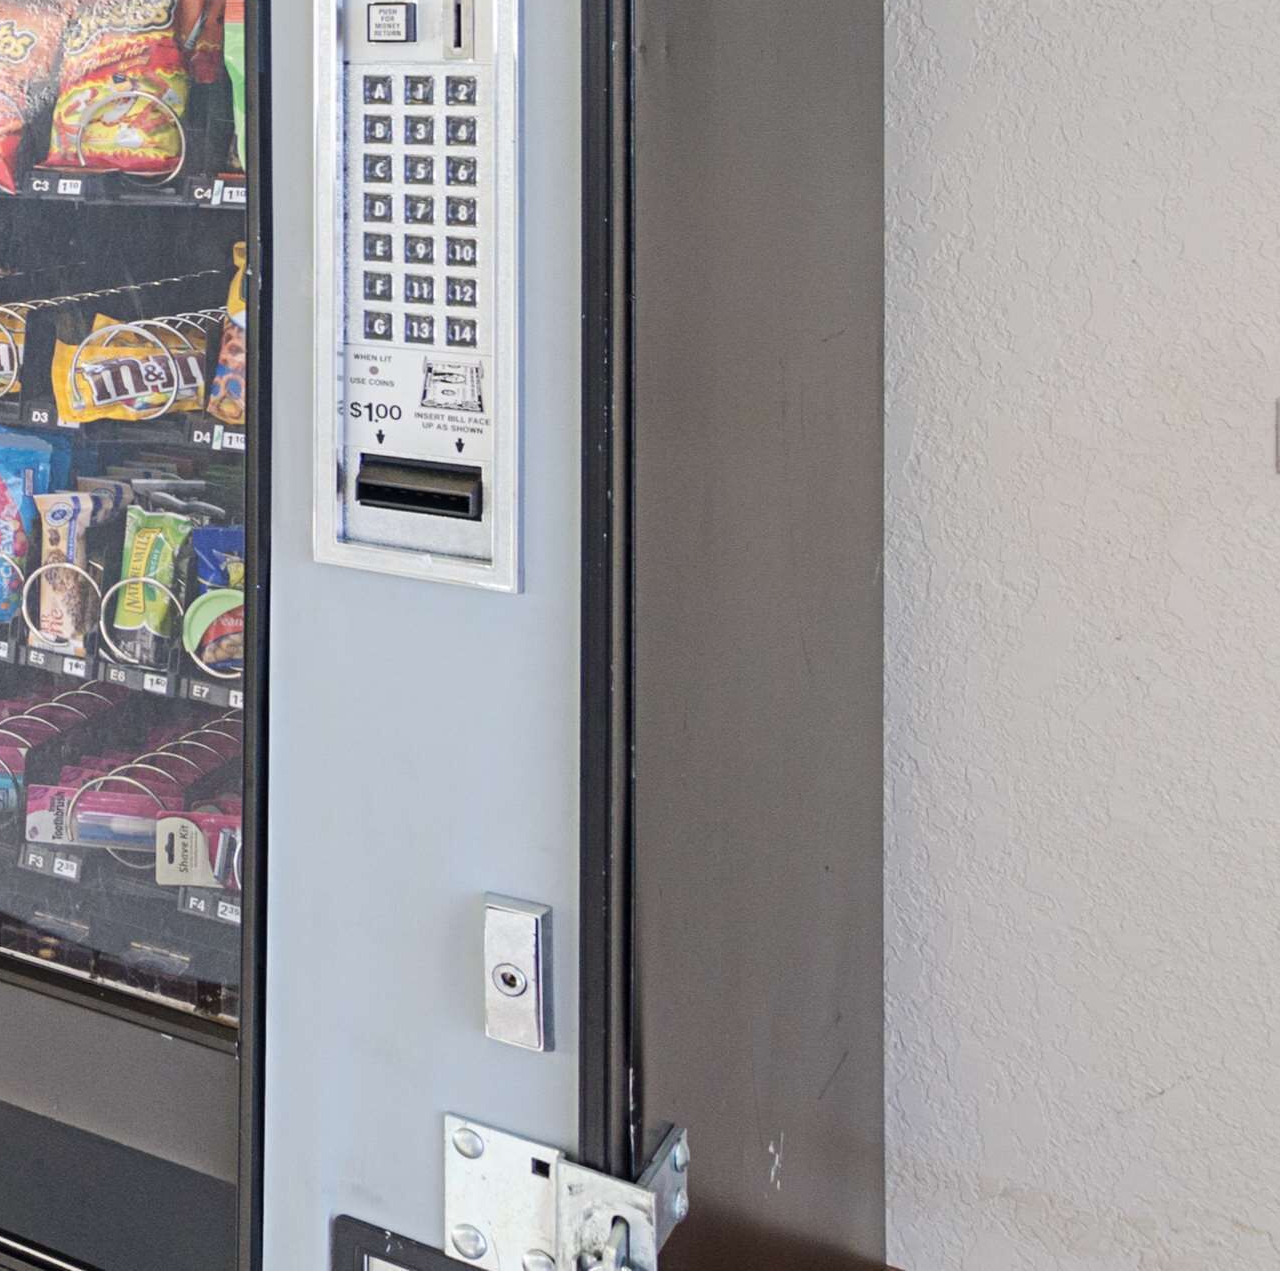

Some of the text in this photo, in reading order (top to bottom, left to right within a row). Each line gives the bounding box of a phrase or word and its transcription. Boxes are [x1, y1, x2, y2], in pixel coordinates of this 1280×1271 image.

[378, 8, 398, 16] PUSH
[373, 83, 386, 99] A
[415, 83, 424, 99] 1
[457, 84, 468, 101] 2
[375, 122, 385, 138] B
[415, 123, 426, 140] 3
[457, 124, 468, 141] 4
[375, 161, 386, 178] C
[415, 163, 426, 179] 5
[457, 164, 468, 181] 6
[33, 181, 49, 191] C3
[194, 188, 212, 199] C4
[374, 201, 385, 217] D
[415, 202, 426, 219] 7
[458, 204, 468, 221] 8
[375, 240, 385, 256] E
[415, 243, 426, 259] 9
[454, 244, 473, 261] 10
[375, 279, 384, 296] F
[412, 282, 429, 299] 11
[454, 284, 474, 302] 12
[374, 318, 386, 335] G
[411, 321, 430, 339] 13
[453, 324, 472, 342] 14
[353, 353, 393, 363] WHEN LIT
[349, 377, 396, 387] USE COINS
[31, 411, 49, 423] D3
[349, 401, 403, 423] $1.00
[414, 411, 491, 426] INSERT BILL FACE
[421, 422, 484, 435] UP AS SHOWN
[193, 431, 211, 443] D4
[125, 564, 145, 609] NATURE
[29, 653, 45, 665] E5
[110, 669, 126, 681] E6
[193, 685, 210, 698] E7
[51, 791, 65, 840] Toothbrush
[178, 825, 190, 873] Shave Kit
[28, 854, 44, 867] F3
[189, 897, 205, 912] F4
